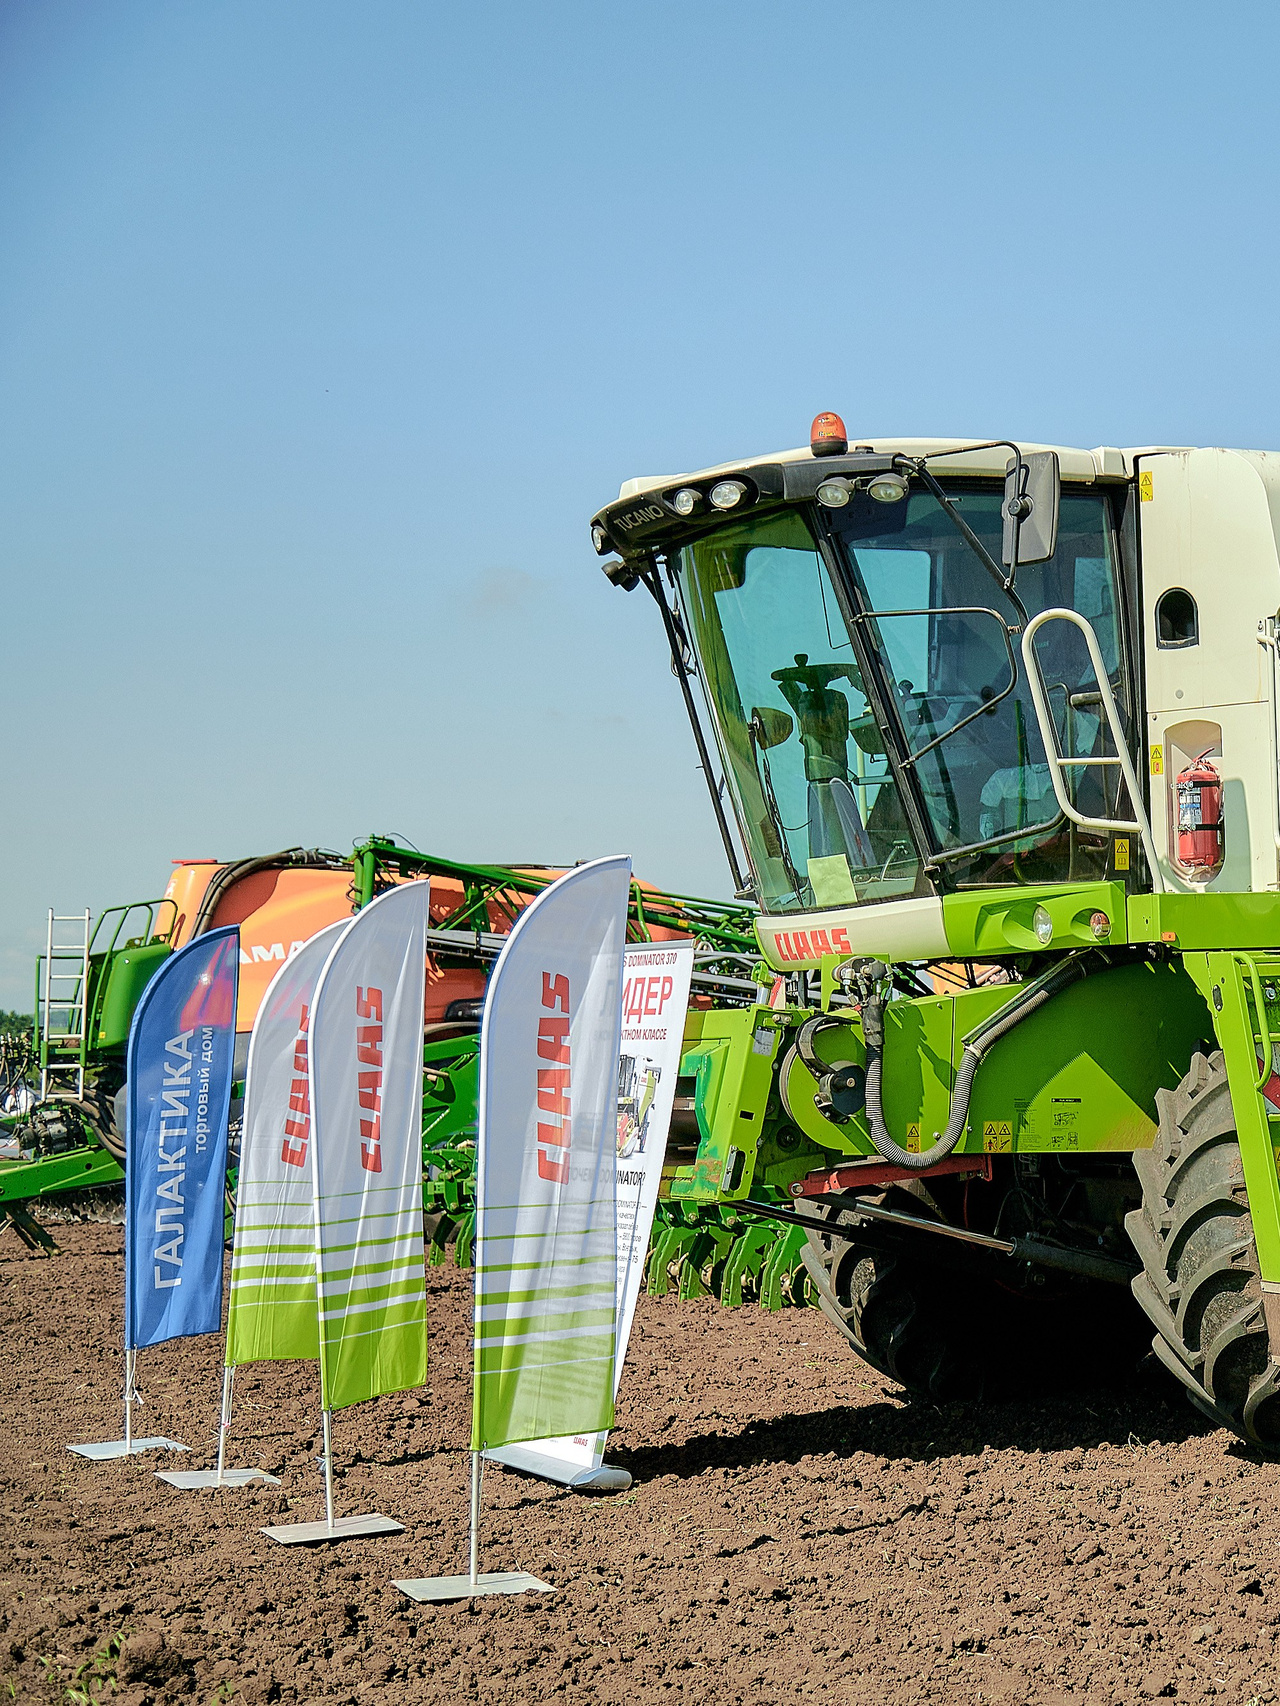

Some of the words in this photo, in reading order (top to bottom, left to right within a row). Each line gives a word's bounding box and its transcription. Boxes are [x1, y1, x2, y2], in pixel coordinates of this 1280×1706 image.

[613, 504, 665, 533] TUCANO
[628, 954, 665, 967] DOMINATOR
[666, 952, 678, 965] 370
[774, 928, 852, 961] CLAAS
[643, 1028, 668, 1041] КЛАССЕ
[356, 985, 383, 1173] CLAAS
[537, 971, 571, 1184] CLAAS
[194, 1068, 212, 1154] торговый
[153, 1028, 195, 1289] ГАЛАКТИКА
